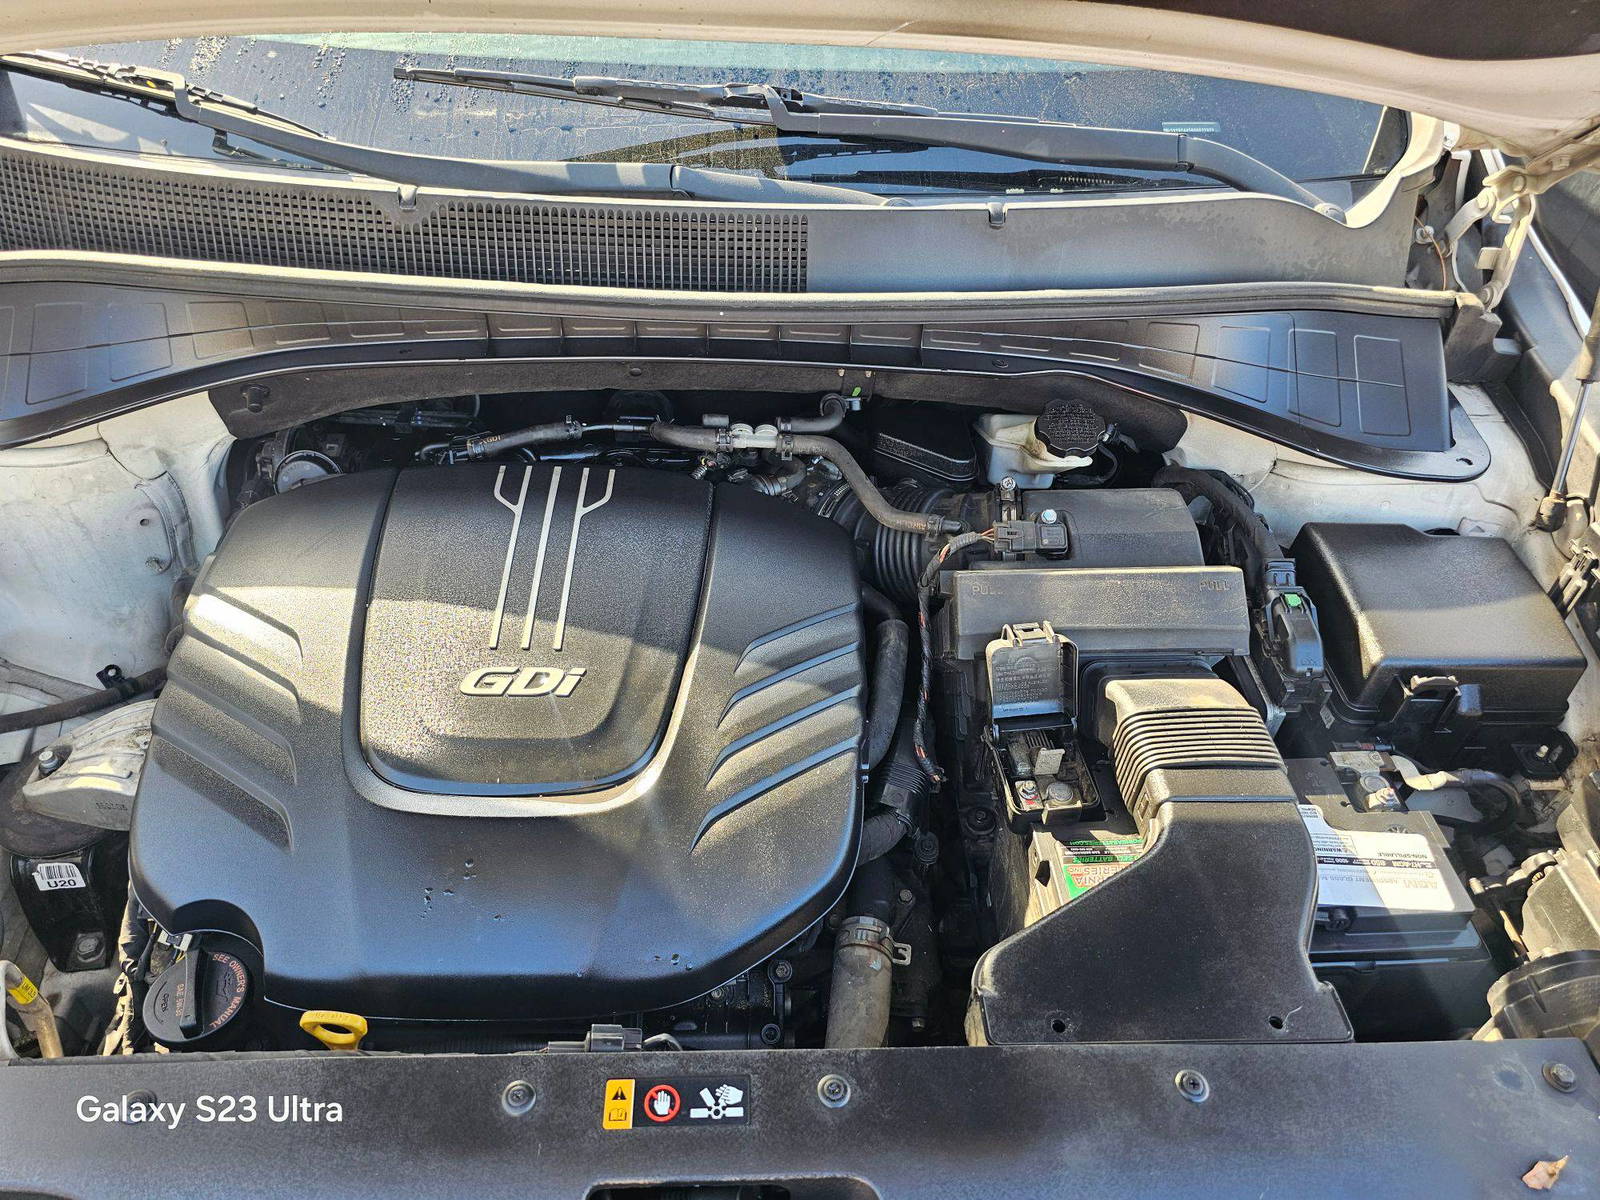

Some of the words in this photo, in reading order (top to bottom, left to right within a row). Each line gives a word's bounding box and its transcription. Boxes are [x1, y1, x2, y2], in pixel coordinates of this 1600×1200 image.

[1200, 580, 1231, 592] PULL
[460, 666, 588, 698] GDi
[1084, 867, 1122, 876] ERIES
[47, 879, 77, 889] U20
[212, 952, 230, 963] SEE
[229, 960, 248, 993] OWNER'S
[161, 993, 169, 1012] OPEN
[209, 996, 242, 1028] MANUAL
